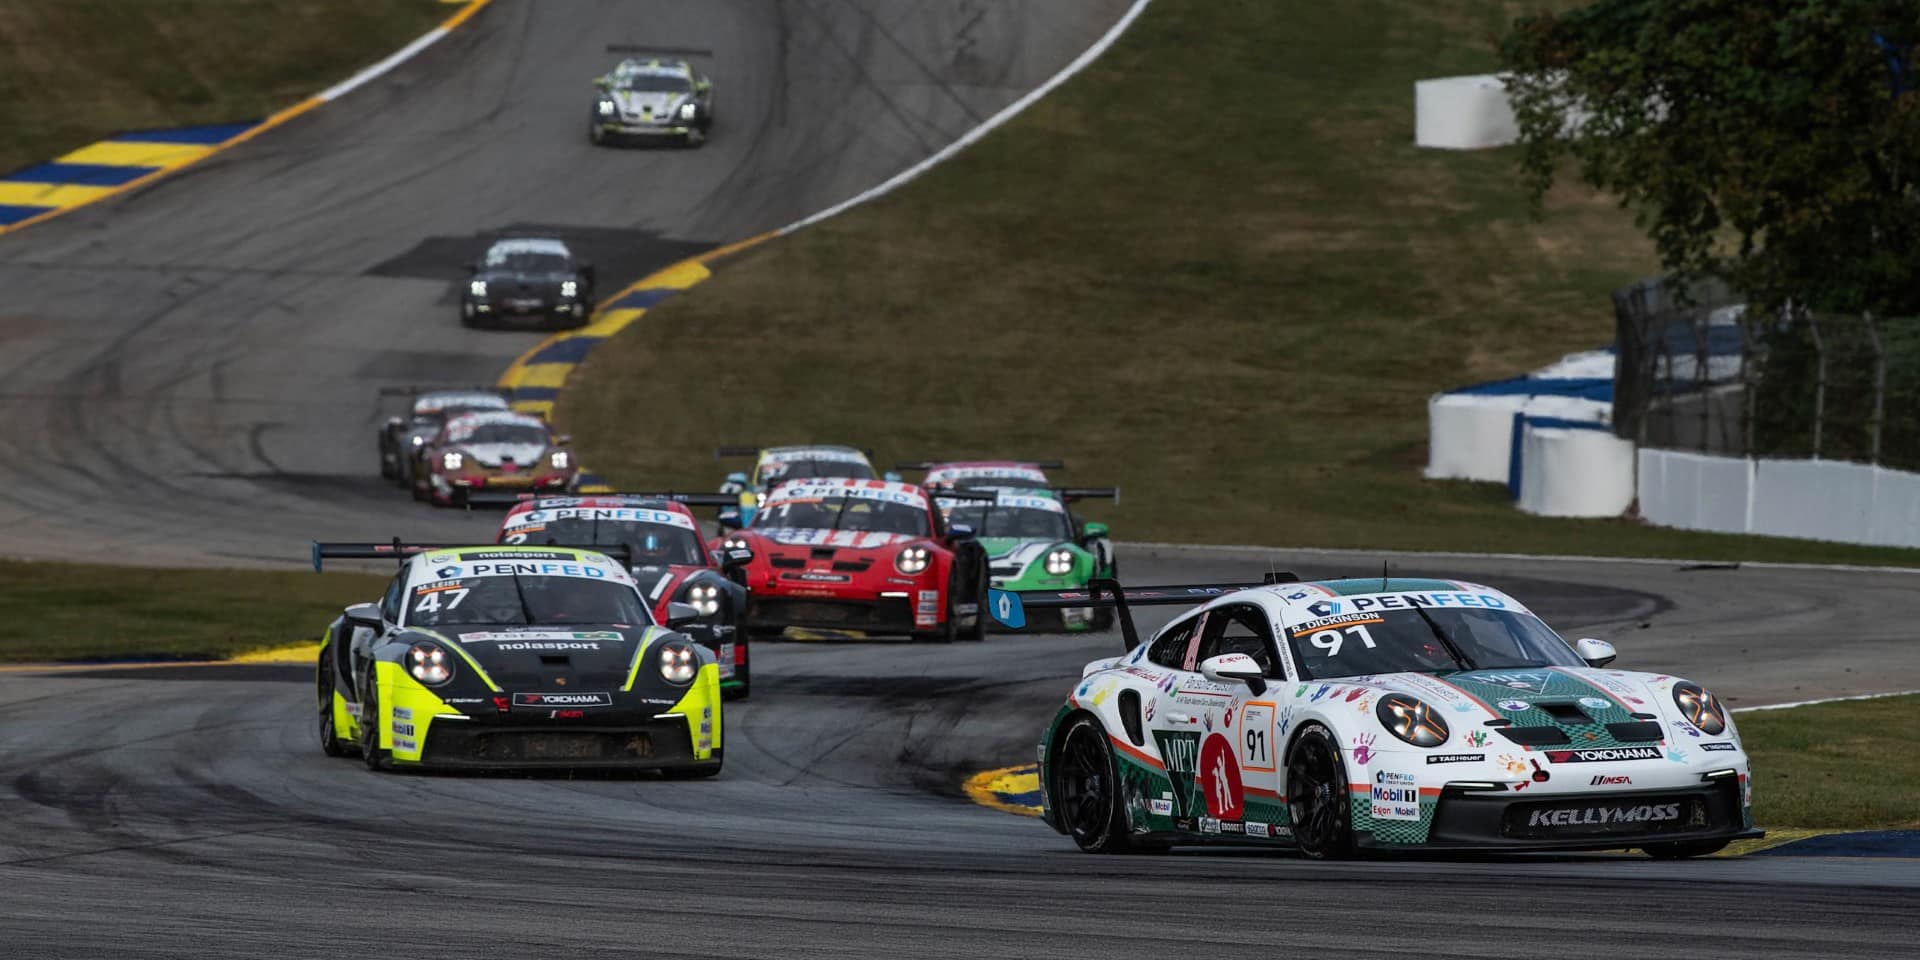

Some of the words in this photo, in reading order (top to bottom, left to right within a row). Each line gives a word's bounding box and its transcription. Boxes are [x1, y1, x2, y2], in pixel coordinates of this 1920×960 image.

[812, 488, 908, 503] PENFED
[557, 510, 672, 522] PENFED
[479, 552, 558, 561] nolasport
[473, 564, 605, 578] PENFED
[415, 588, 470, 613] 47
[1352, 593, 1505, 611] PENFED
[1307, 612, 1380, 629] DICKINSON
[498, 641, 601, 651] nolasport
[1310, 625, 1377, 657] 91
[542, 695, 601, 704] YOKOHAMA
[1246, 729, 1266, 762] 91
[1164, 738, 1195, 772] MPT
[1575, 748, 1660, 761] YOKOHAMA
[1386, 772, 1414, 781] PENFED
[1602, 776, 1631, 785] IMSA
[1374, 787, 1403, 802] Mobil
[1395, 807, 1416, 817] Mobil
[1527, 803, 1680, 827] KELLYMOSS
